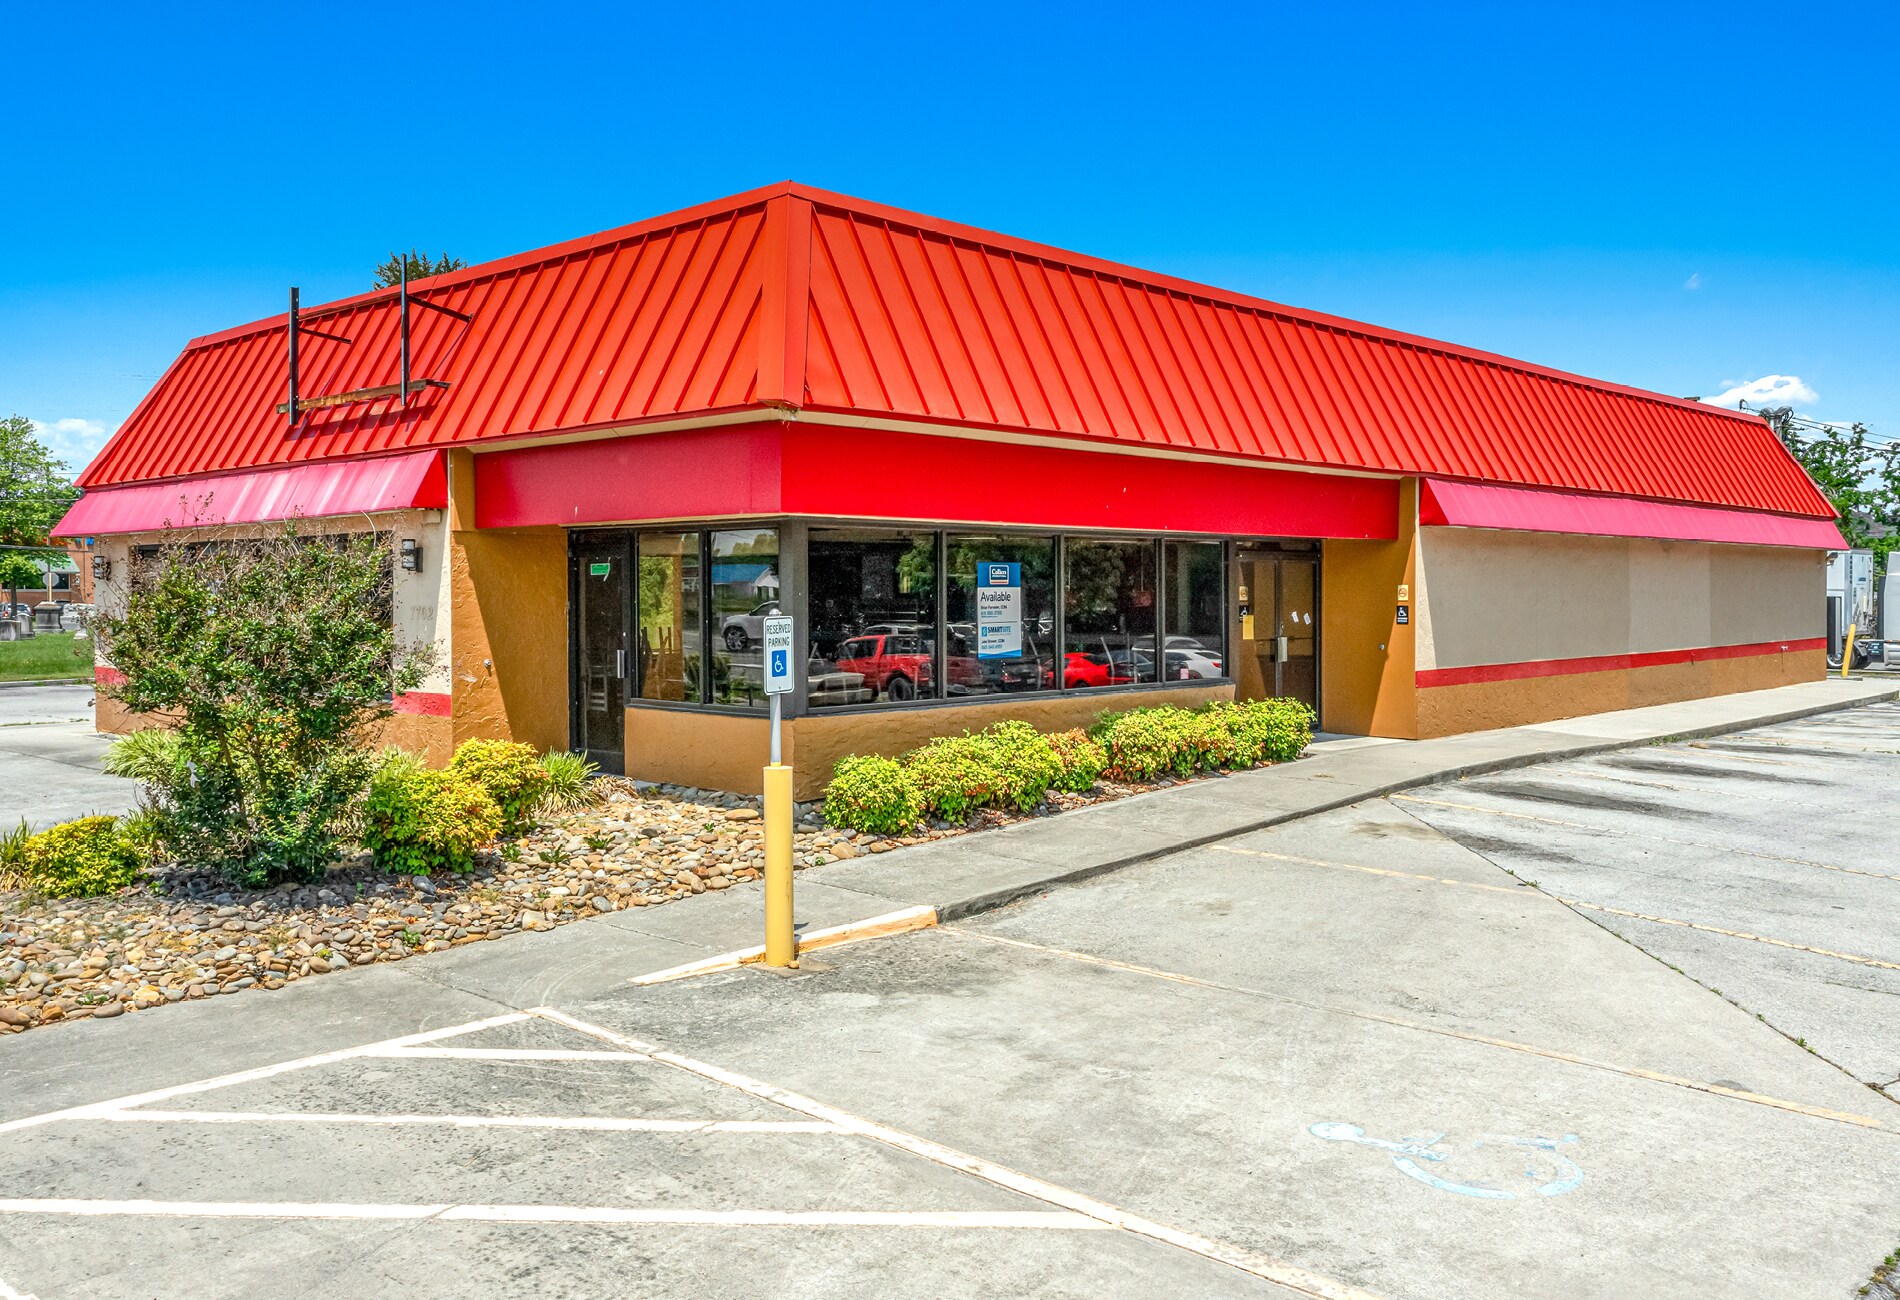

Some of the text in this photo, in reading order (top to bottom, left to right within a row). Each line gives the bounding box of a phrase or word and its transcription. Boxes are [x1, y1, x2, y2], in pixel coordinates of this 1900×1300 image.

[980, 591, 1011, 602] Available
[766, 624, 791, 635] RESERVED
[988, 625, 1011, 633] SMARTSITE
[768, 637, 790, 648] PARKING
